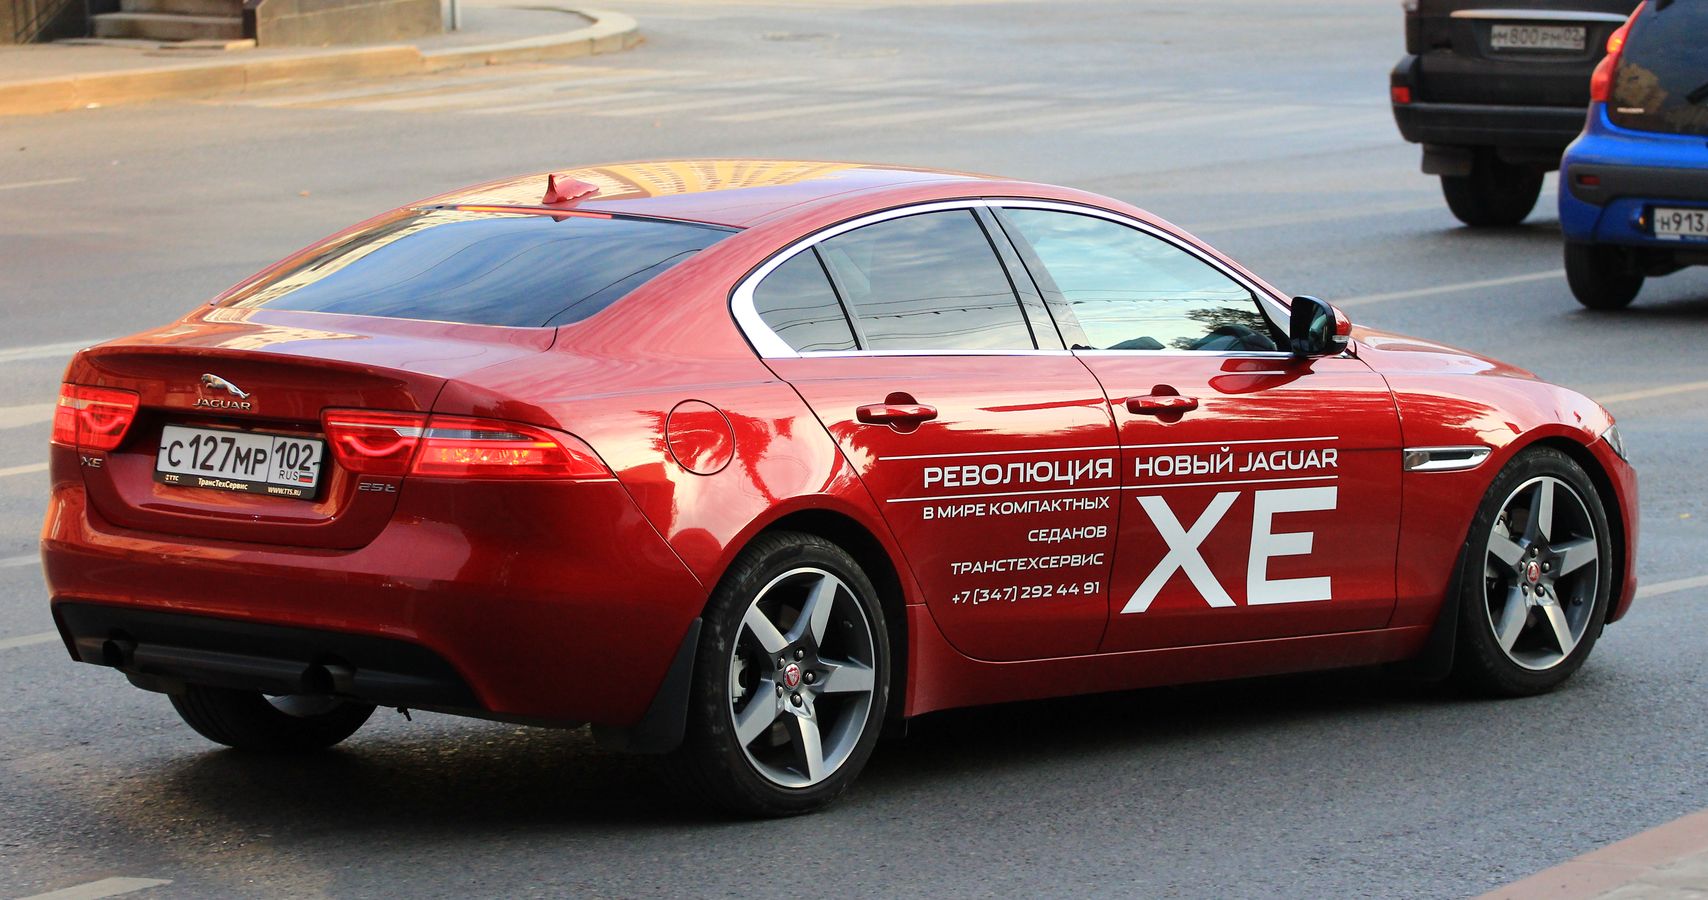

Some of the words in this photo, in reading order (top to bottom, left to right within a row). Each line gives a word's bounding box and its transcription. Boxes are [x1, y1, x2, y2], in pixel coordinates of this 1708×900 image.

[1660, 212, 1708, 232] Н913
[192, 398, 251, 410] JAGUAR
[81, 456, 102, 468] XE
[275, 441, 314, 472] 102
[1135, 445, 1234, 478] НОВЫЙ
[1238, 448, 1338, 473] JAGUAR
[198, 477, 248, 490] ТрансТехСервис
[278, 469, 299, 481] RUS
[923, 457, 1114, 489] РЕВОЛЮЦИЯ
[267, 486, 302, 497] WWW.TTS.RU
[922, 505, 934, 520] В
[937, 502, 986, 519] МИРЕ
[988, 496, 1110, 516] КОМПАКТНЫХ
[1027, 525, 1108, 544] СЕДАНОВ
[1120, 486, 1338, 614] XE
[950, 553, 1105, 576] ТРАНСТЕХСЕРВИС
[951, 590, 970, 605] +7
[1020, 583, 1054, 600] 292
[1056, 582, 1080, 597] 44
[1083, 581, 1100, 596] 91
